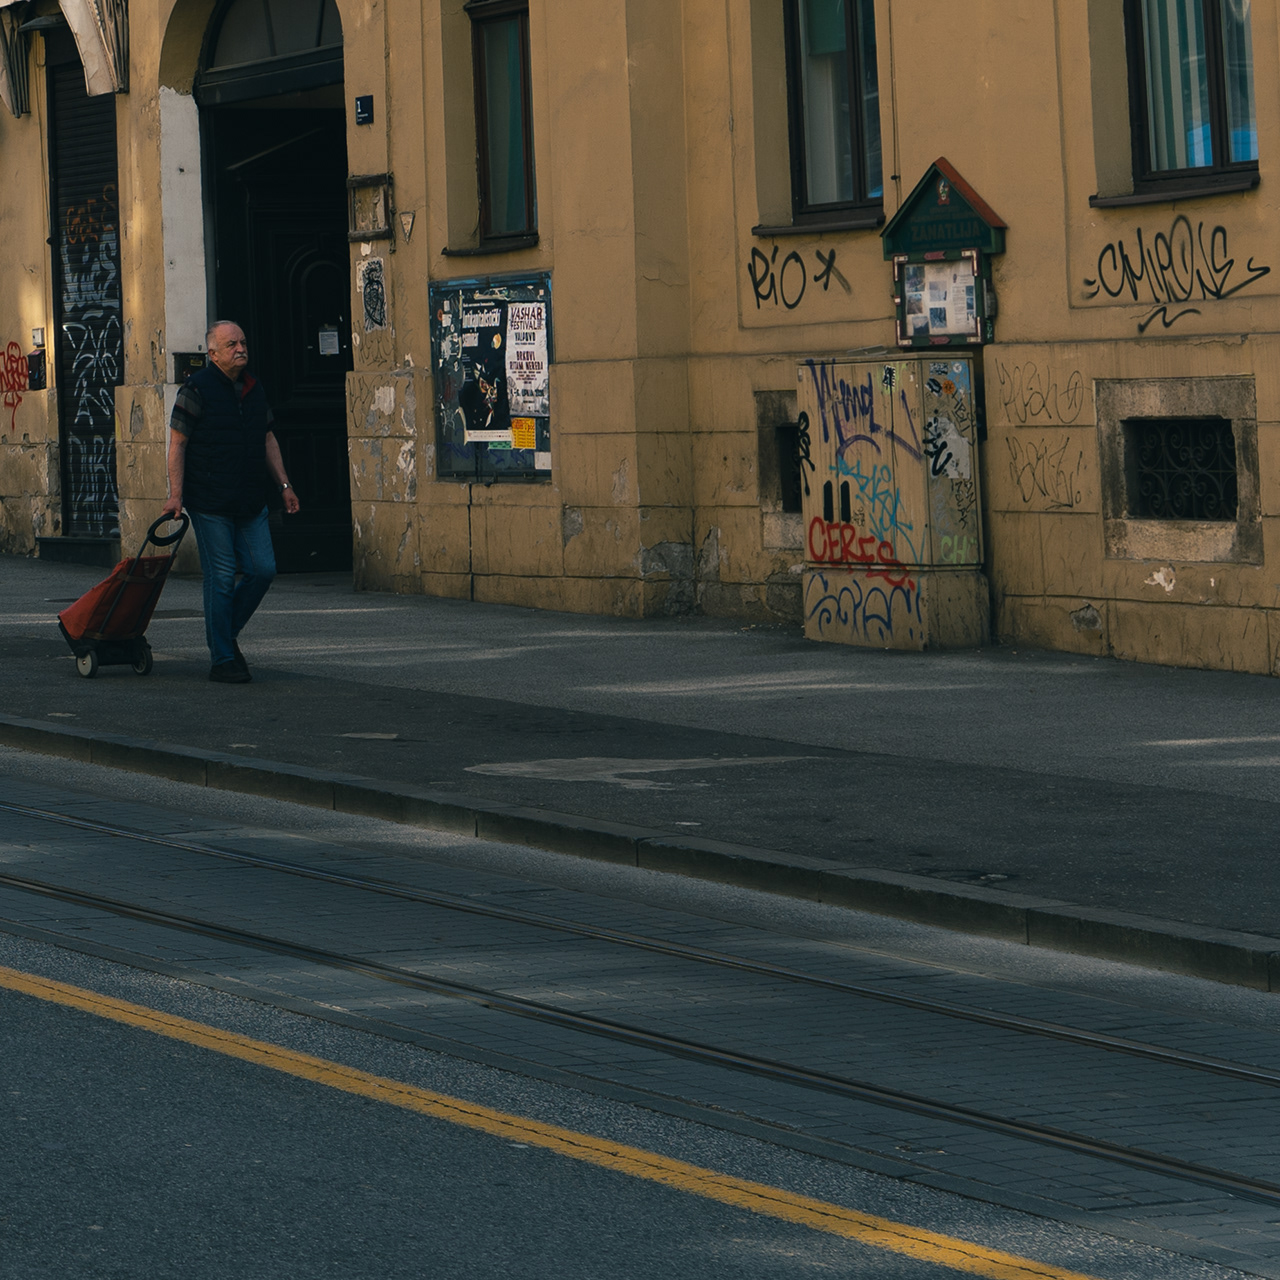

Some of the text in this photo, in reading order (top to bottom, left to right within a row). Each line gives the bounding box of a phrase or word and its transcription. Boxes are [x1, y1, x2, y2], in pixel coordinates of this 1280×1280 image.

[357, 100, 362, 112] 1
[511, 307, 543, 320] VASHAR
[510, 319, 537, 330] FESTIVAL
